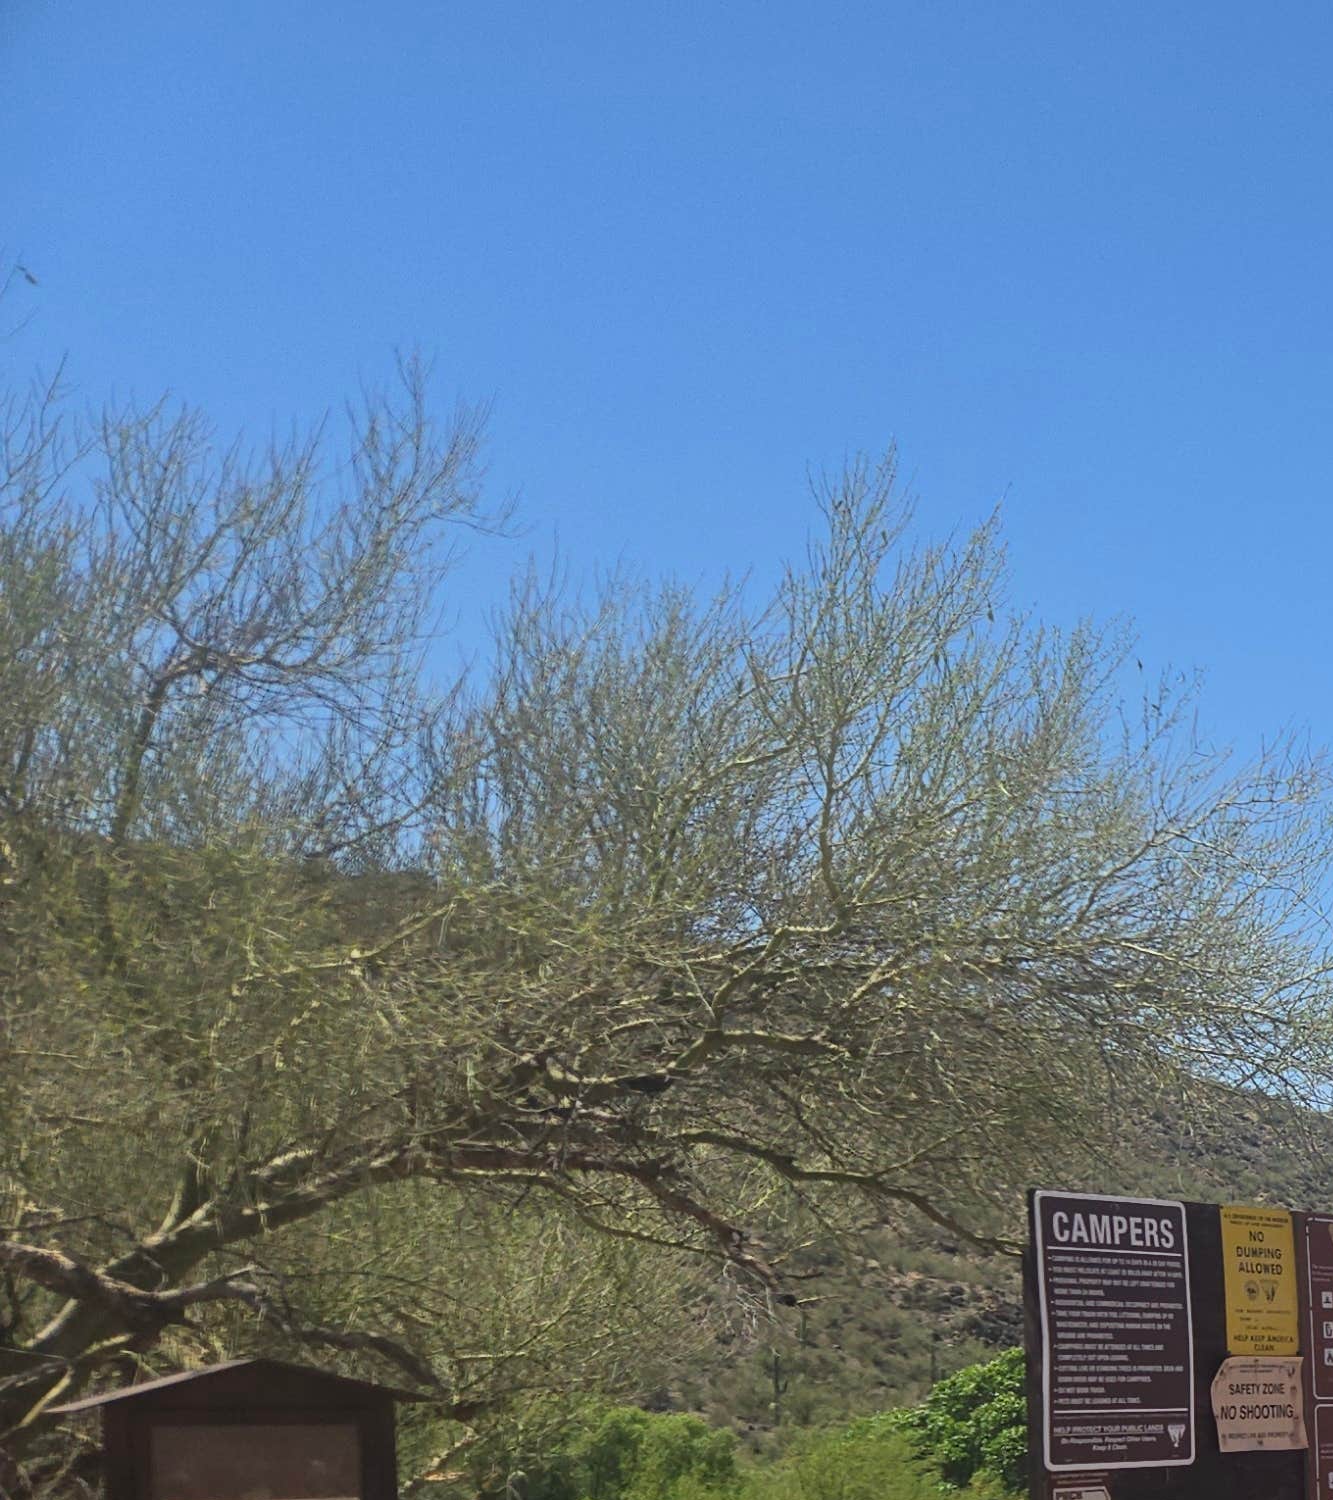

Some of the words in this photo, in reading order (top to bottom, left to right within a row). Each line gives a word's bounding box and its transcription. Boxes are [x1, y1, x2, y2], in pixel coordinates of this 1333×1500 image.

[1052, 1210, 1175, 1249] CAMPERS
[1249, 1230, 1265, 1242] NO
[1236, 1246, 1282, 1259] DUMPING
[1239, 1262, 1283, 1275] ALLOWED
[1267, 1335, 1294, 1343] AMERICA
[1228, 1383, 1261, 1395] SAFETY
[1262, 1383, 1285, 1394] ZONE
[1221, 1405, 1237, 1420] NO
[1239, 1404, 1294, 1420] SHOOTING
[1072, 1425, 1101, 1433] PROTECT
[1121, 1424, 1143, 1432] PUBLIC
[1144, 1423, 1164, 1432] LANDS
